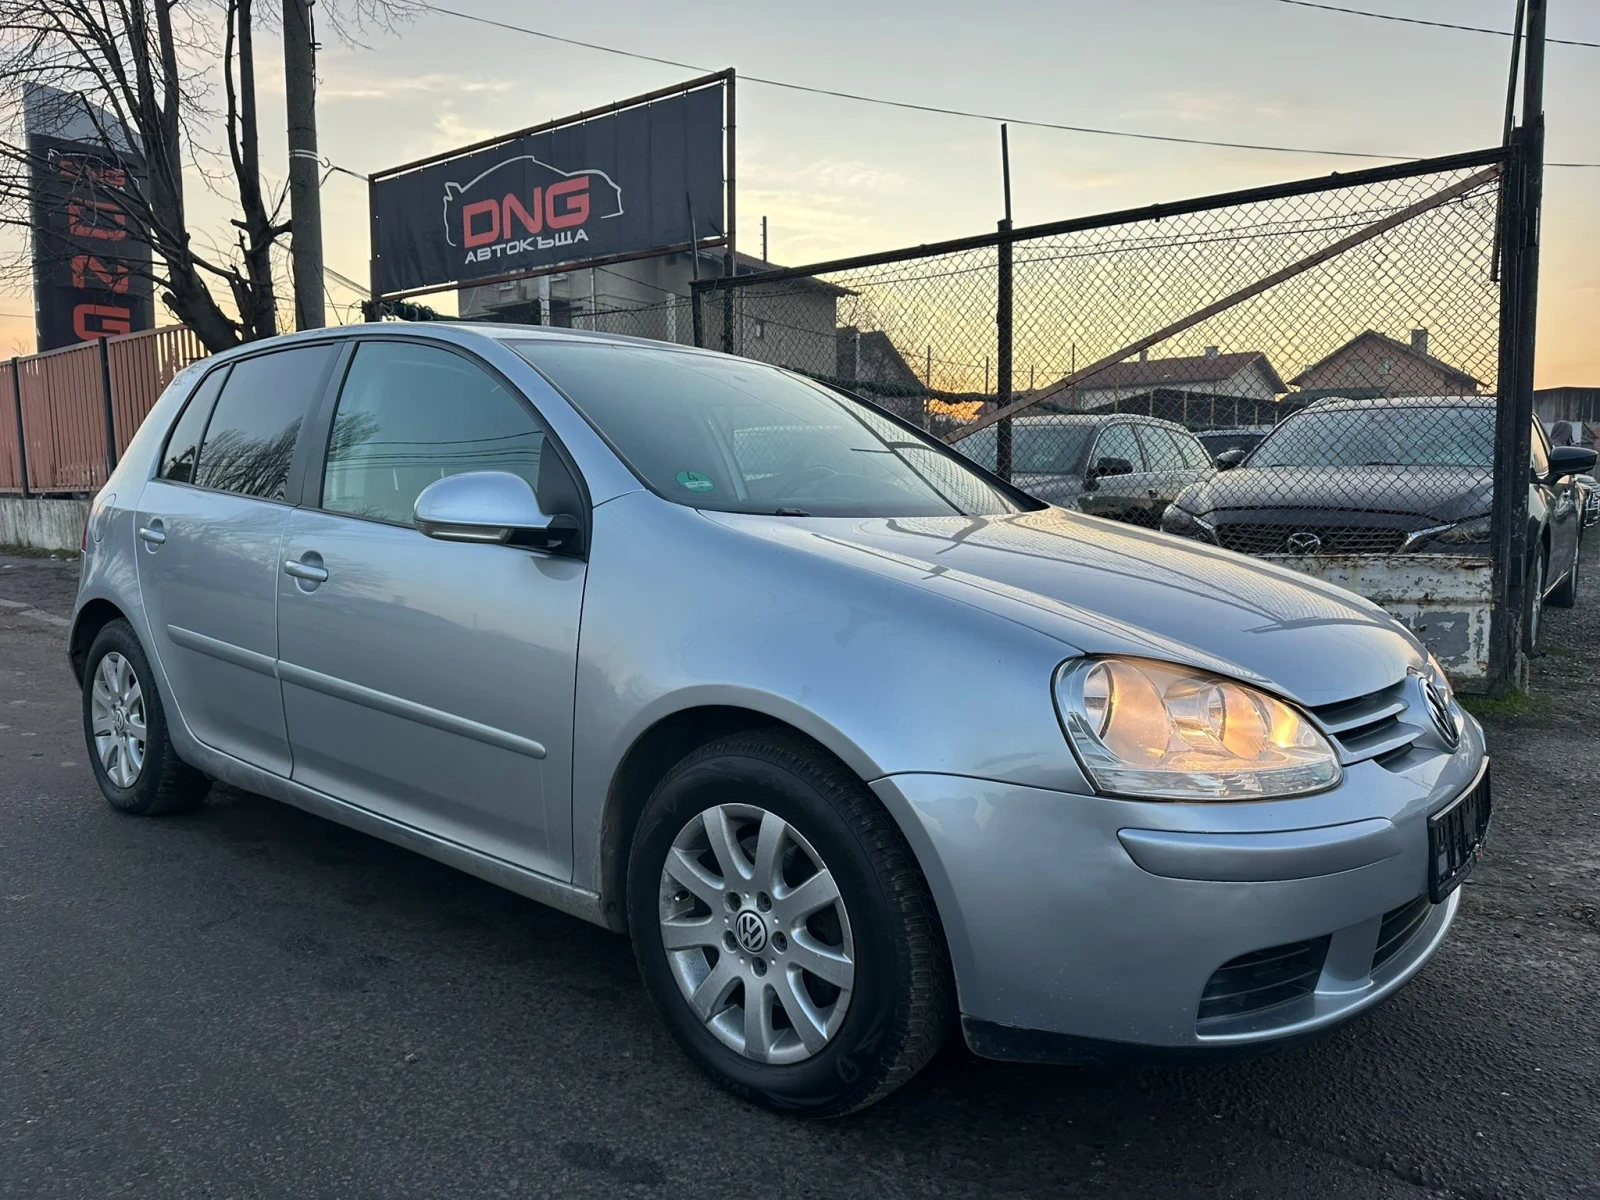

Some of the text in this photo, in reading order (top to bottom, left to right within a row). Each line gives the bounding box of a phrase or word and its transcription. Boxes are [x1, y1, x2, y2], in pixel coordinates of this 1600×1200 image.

[463, 176, 590, 248] DNG
[69, 198, 130, 341] DNG
[465, 228, 589, 264] АВТОКЪЩА
[686, 471, 699, 481] 4
